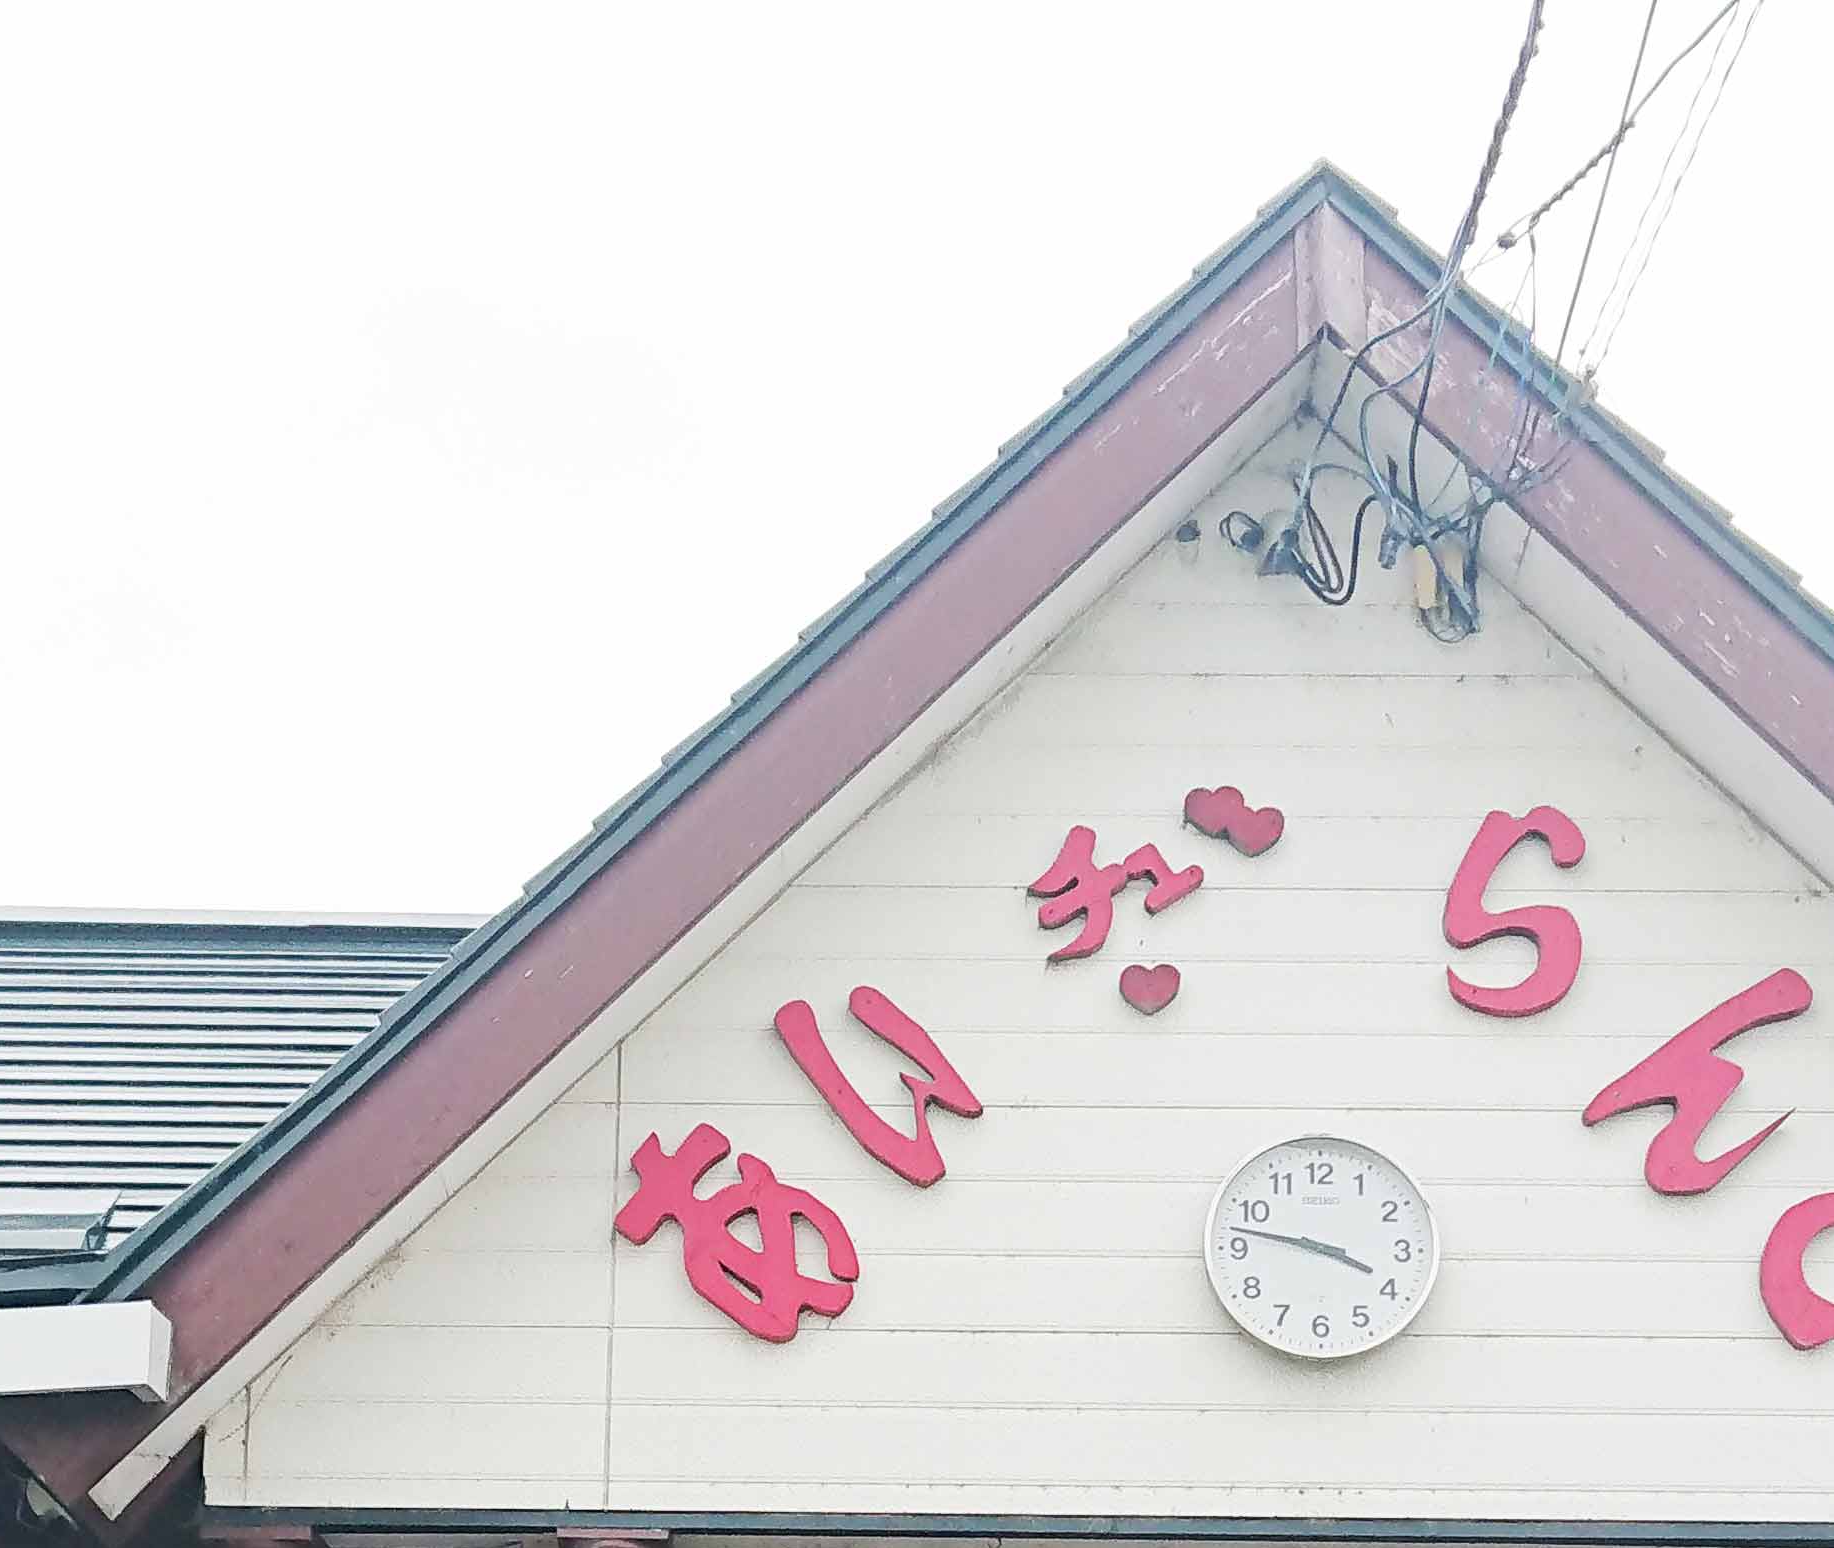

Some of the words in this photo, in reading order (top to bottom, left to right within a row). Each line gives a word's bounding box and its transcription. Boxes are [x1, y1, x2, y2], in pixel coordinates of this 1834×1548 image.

[1269, 1172, 1293, 1195] 11
[1304, 1162, 1334, 1185] 12
[1353, 1173, 1364, 1196] 1
[1238, 1199, 1270, 1223] 10
[1381, 1201, 1398, 1222] 2
[1230, 1236, 1249, 1260] 9
[1394, 1239, 1411, 1262] 3
[1243, 1276, 1261, 1299] 8
[1379, 1278, 1398, 1301] 4
[1273, 1304, 1291, 1327] 7
[1312, 1315, 1330, 1338] 6
[1352, 1305, 1370, 1328] 5
